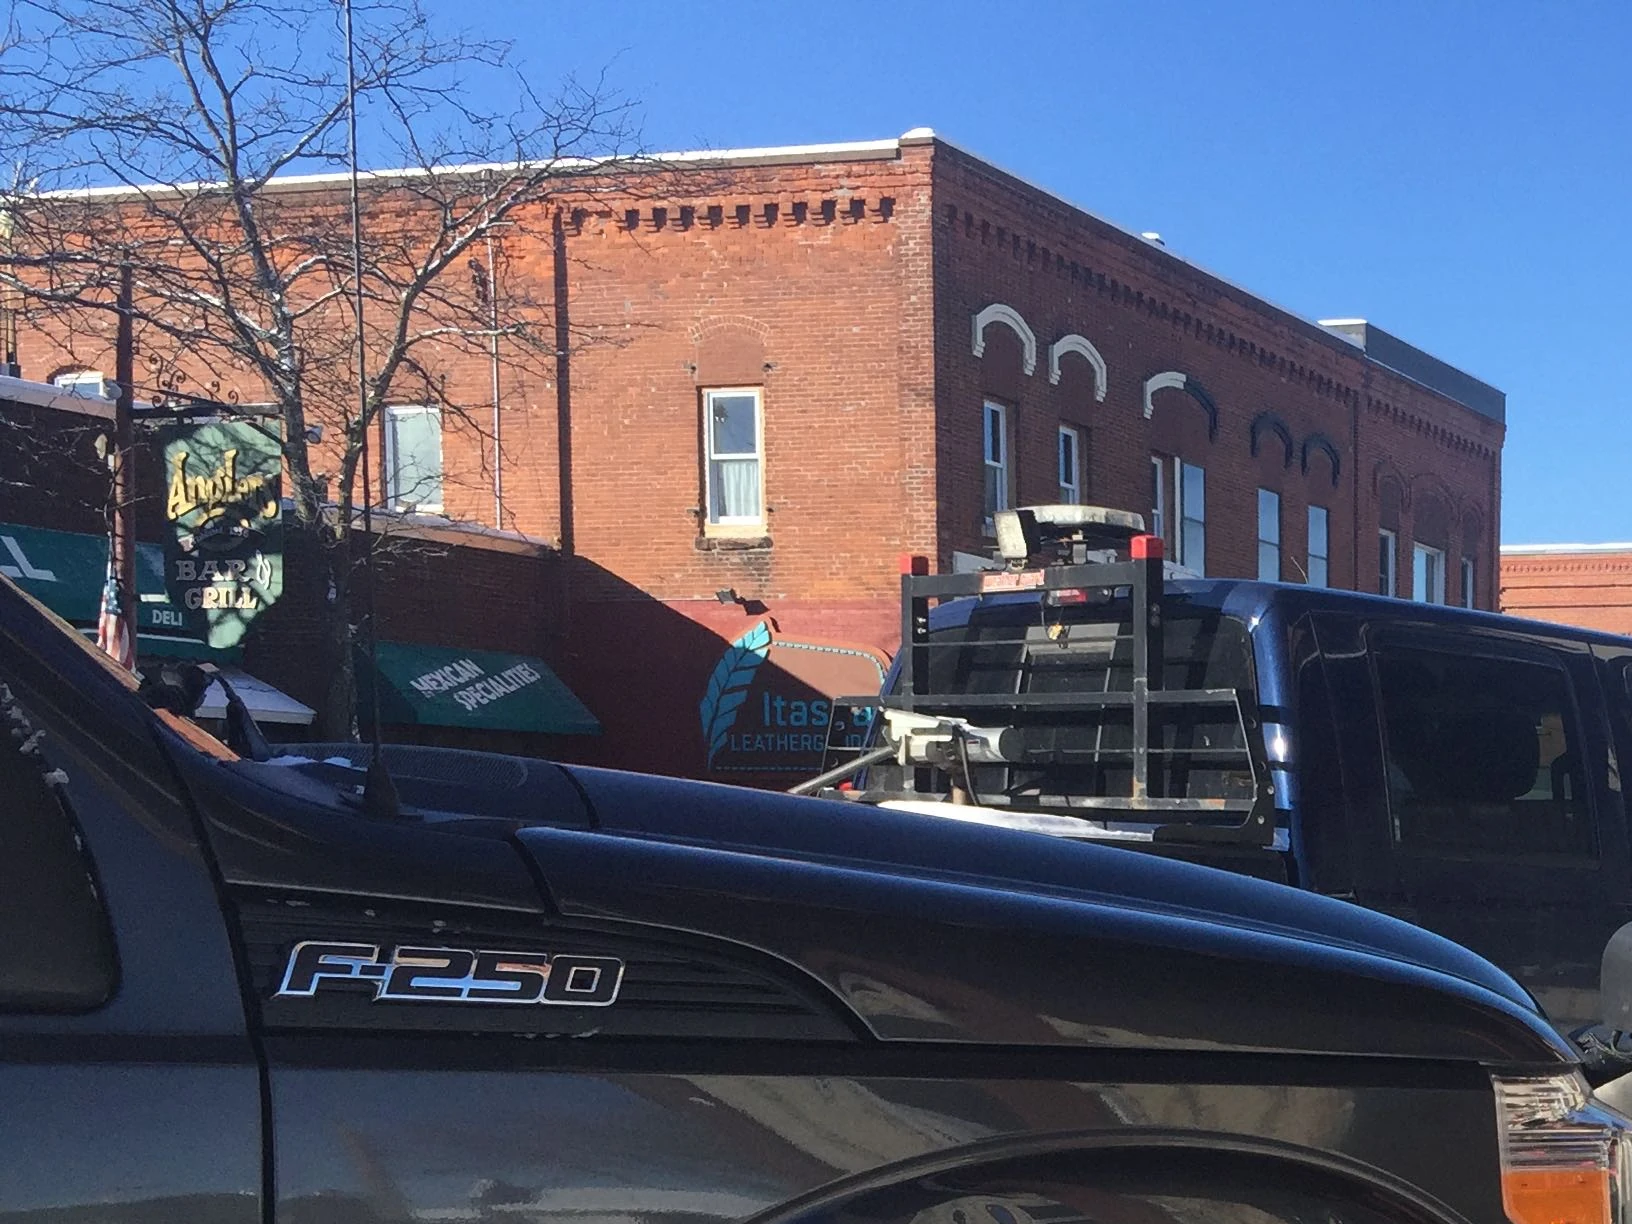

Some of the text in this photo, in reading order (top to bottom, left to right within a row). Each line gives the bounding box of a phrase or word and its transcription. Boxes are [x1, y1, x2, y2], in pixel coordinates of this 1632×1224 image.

[175, 559, 250, 582] BAR
[184, 586, 257, 610] GRILL
[152, 609, 183, 627] DELI
[409, 658, 485, 696] MEXICAN
[453, 662, 541, 711] SPECIALITIES
[763, 691, 873, 728] Itasa
[270, 940, 626, 1007] F-250
